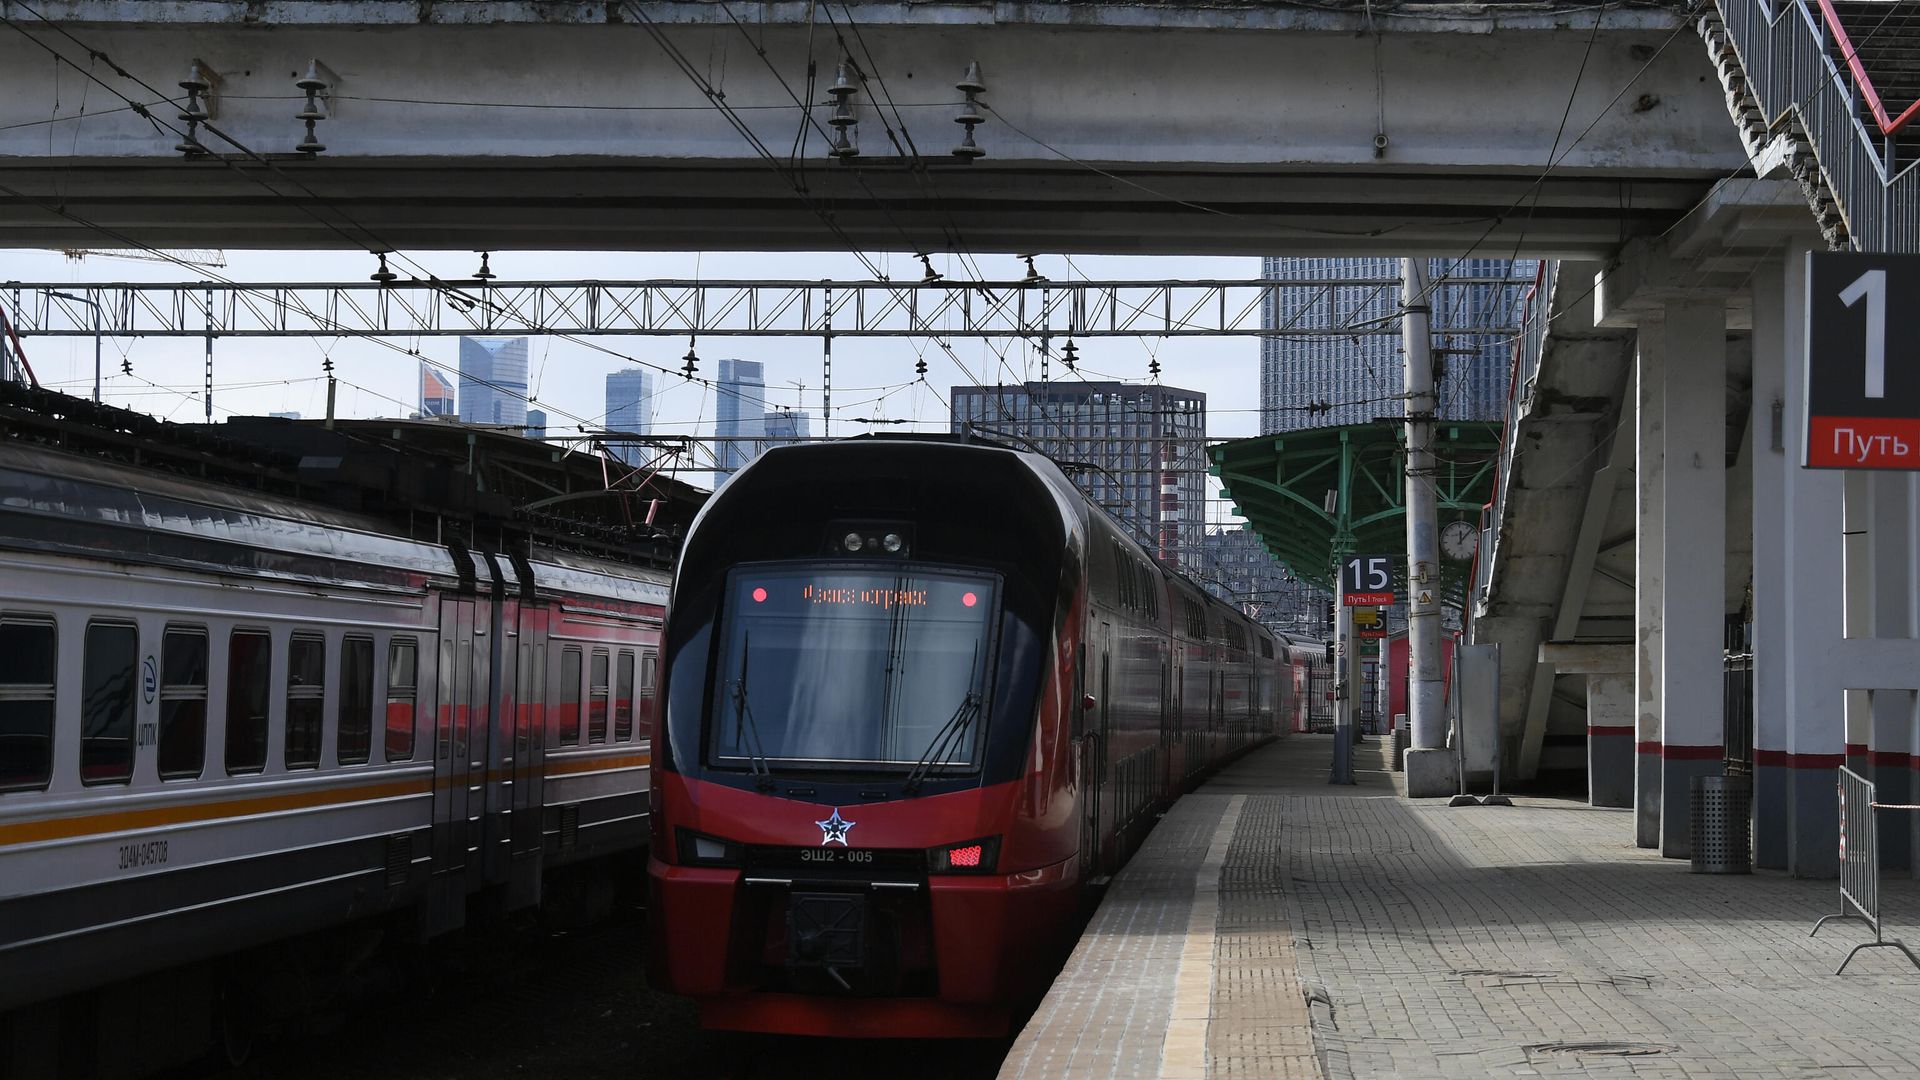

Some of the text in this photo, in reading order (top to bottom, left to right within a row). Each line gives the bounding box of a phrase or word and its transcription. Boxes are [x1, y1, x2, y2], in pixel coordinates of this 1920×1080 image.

[1834, 427, 1909, 462] Путь
[1348, 558, 1388, 590] 15
[1348, 595, 1367, 605] Путь
[138, 722, 156, 750] ЦППК
[801, 849, 834, 862] ЭШ2
[847, 851, 873, 862] 005
